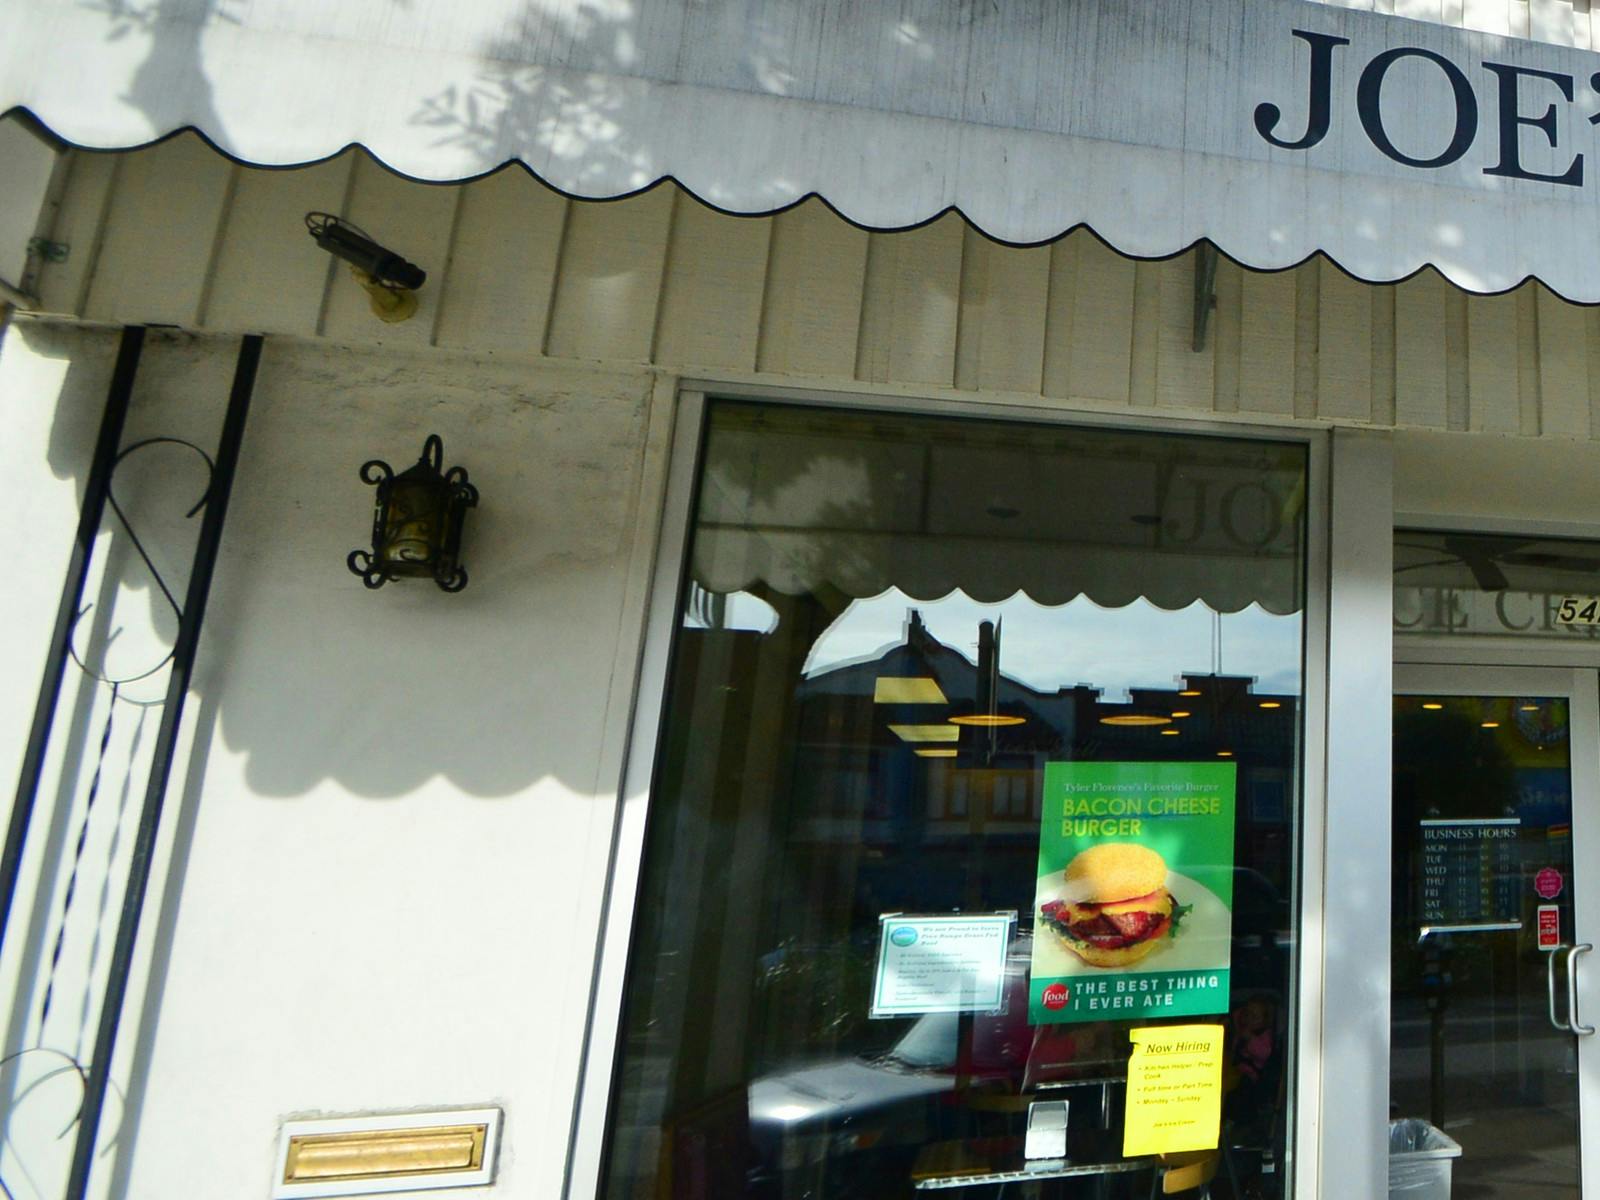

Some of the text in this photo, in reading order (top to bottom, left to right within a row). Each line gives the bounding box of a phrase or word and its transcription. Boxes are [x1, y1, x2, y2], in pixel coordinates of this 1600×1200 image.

[1064, 783, 1219, 793] Tyler Florence's Favorite Burger
[1063, 798, 1220, 816] BACON CHEESE
[1062, 819, 1142, 837] BURGER
[1424, 828, 1517, 840] BUSINESS HOURS
[1425, 844, 1447, 852] MON
[1425, 855, 1442, 864] TUE
[1425, 866, 1447, 874] WED
[1425, 877, 1445, 886] THU
[1425, 888, 1439, 897] FRI
[1425, 900, 1441, 909] SAT
[1425, 911, 1444, 920] SUN
[1075, 976, 1219, 995] THE BEST THING
[1042, 988, 1070, 1005] food
[1074, 993, 1174, 1011] I EVER ATE
[1146, 1042, 1211, 1054] Now Hiring
